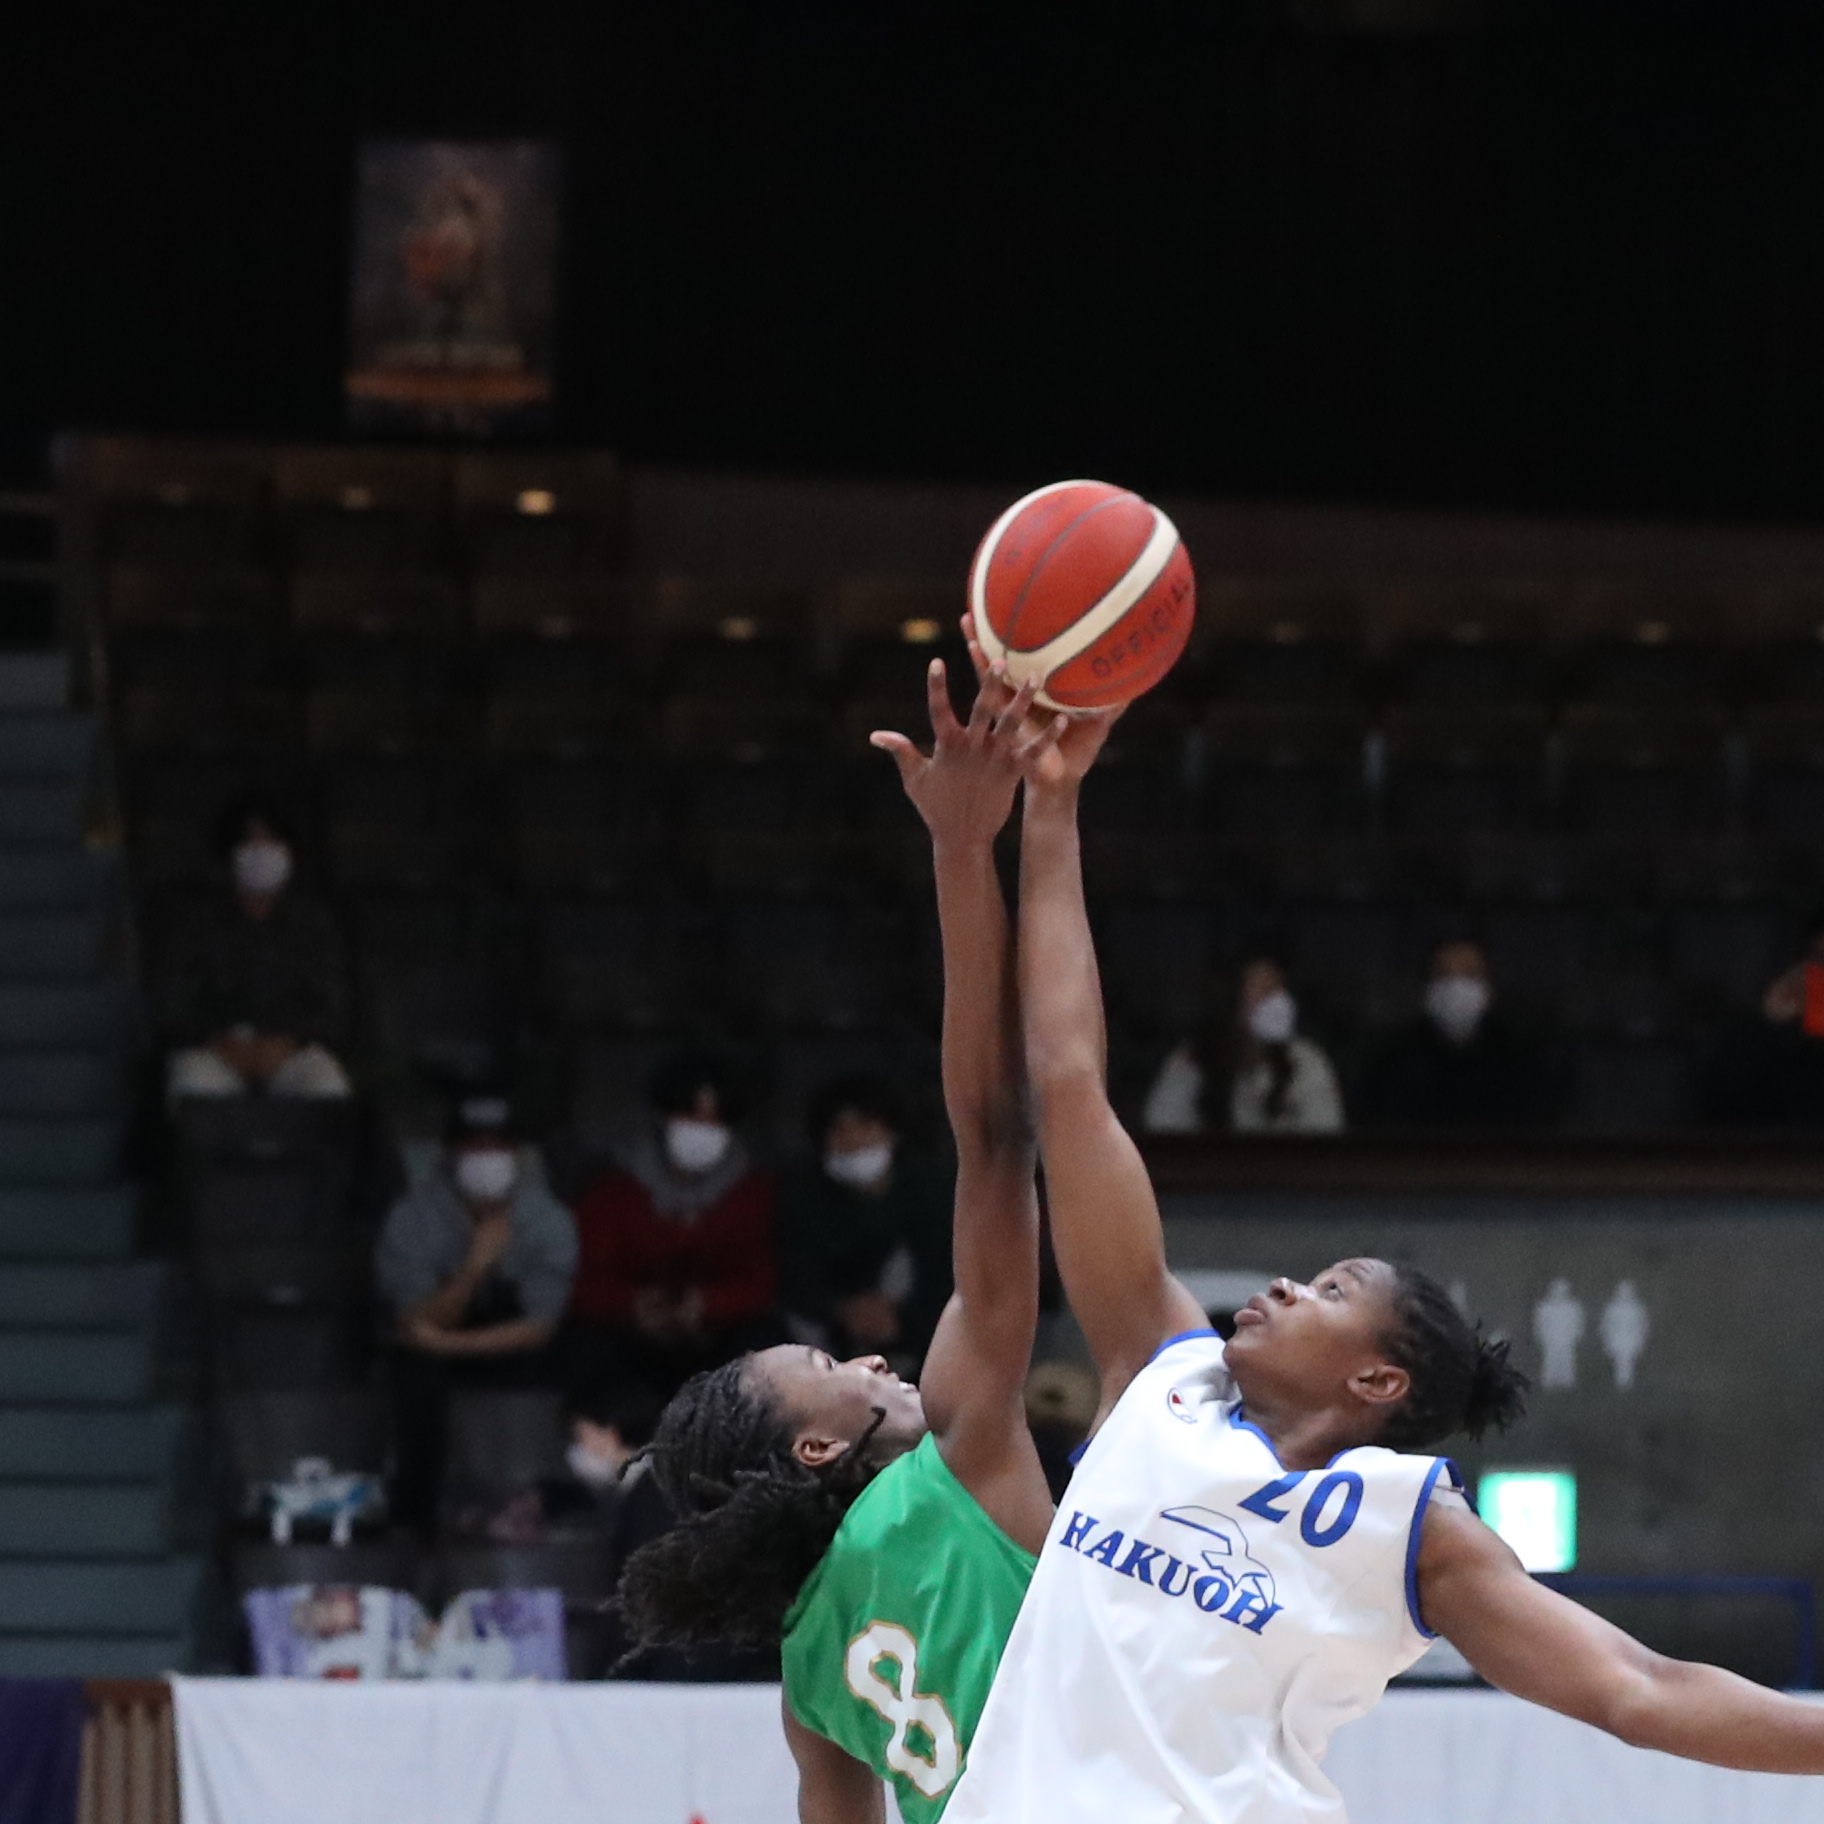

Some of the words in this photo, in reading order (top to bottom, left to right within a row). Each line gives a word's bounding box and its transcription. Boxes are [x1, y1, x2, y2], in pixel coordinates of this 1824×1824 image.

[1237, 1469, 1365, 1548] 20
[1059, 1510, 1284, 1636] HAKUOH
[844, 1620, 963, 1799] 8
